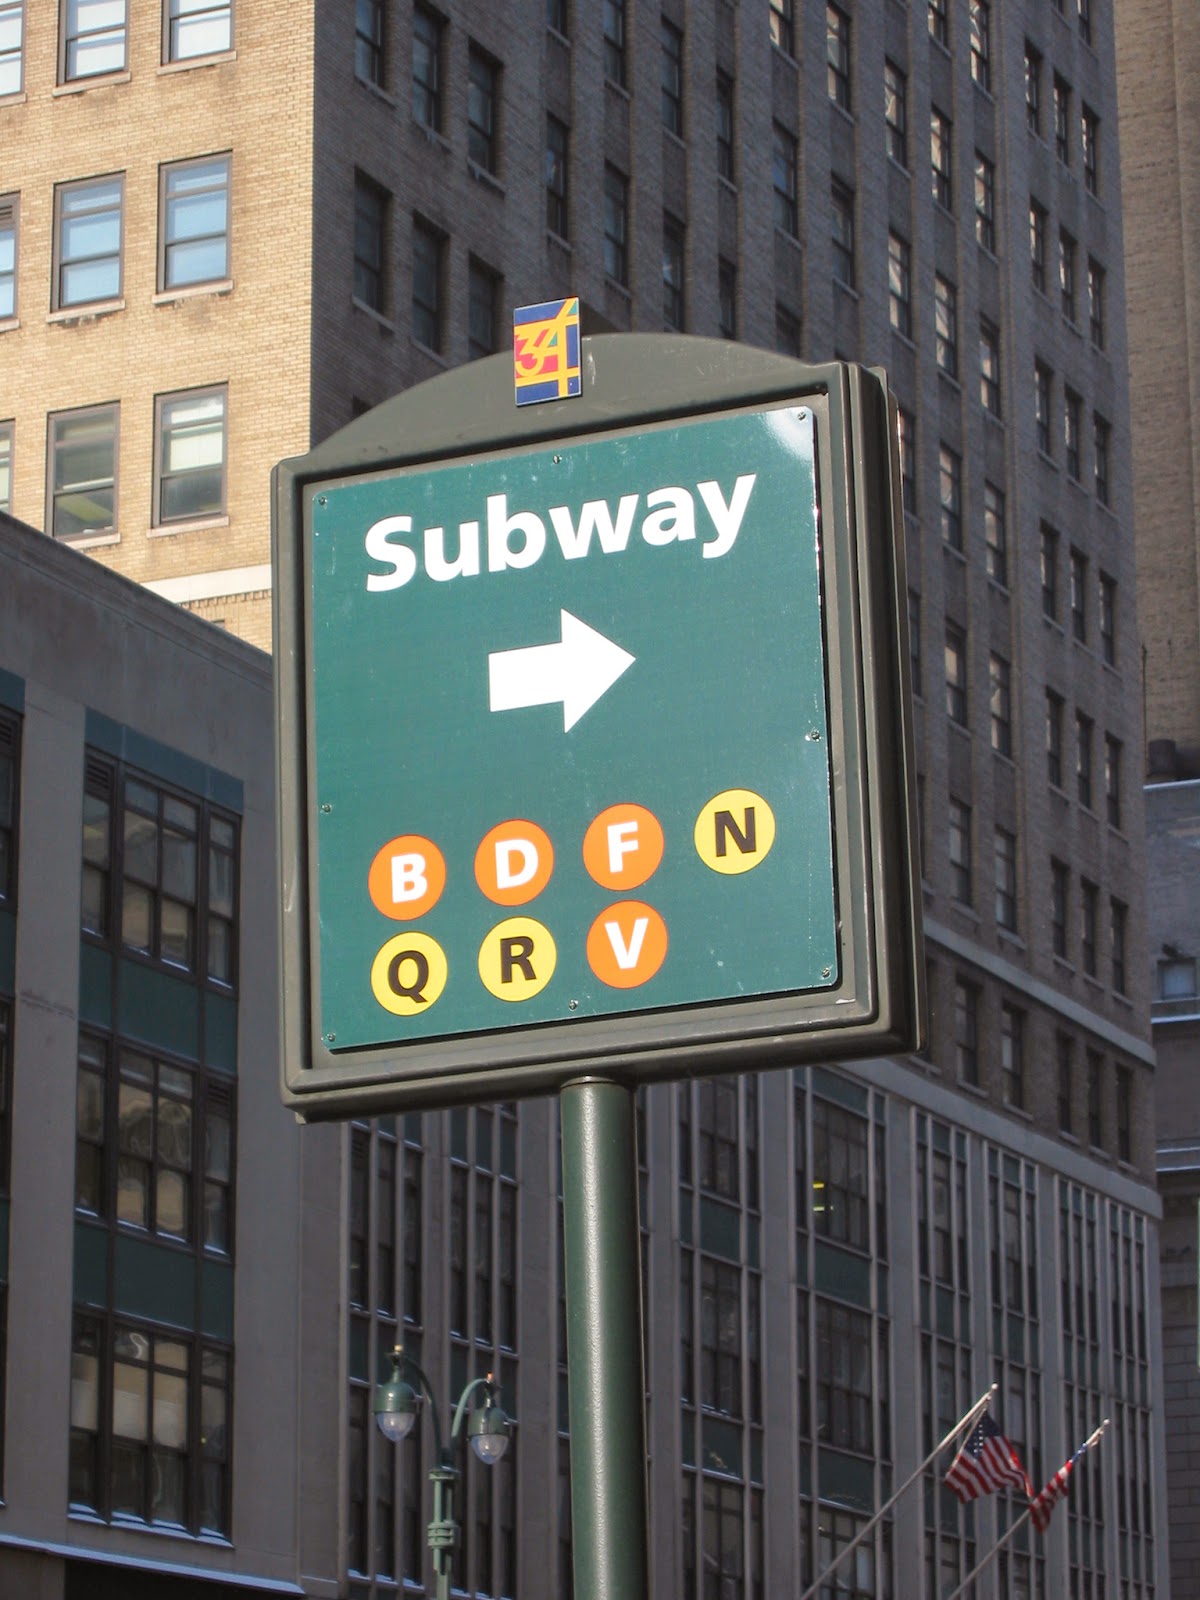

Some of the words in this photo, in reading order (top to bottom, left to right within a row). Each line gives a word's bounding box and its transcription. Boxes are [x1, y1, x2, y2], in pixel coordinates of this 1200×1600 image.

[514, 314, 574, 386] 34
[364, 473, 757, 592] Subway
[390, 852, 428, 904] B
[494, 838, 539, 890] D
[606, 820, 639, 874] F
[715, 806, 757, 857] N
[388, 950, 429, 1004] Q
[500, 936, 536, 984] R
[604, 917, 649, 970] V
